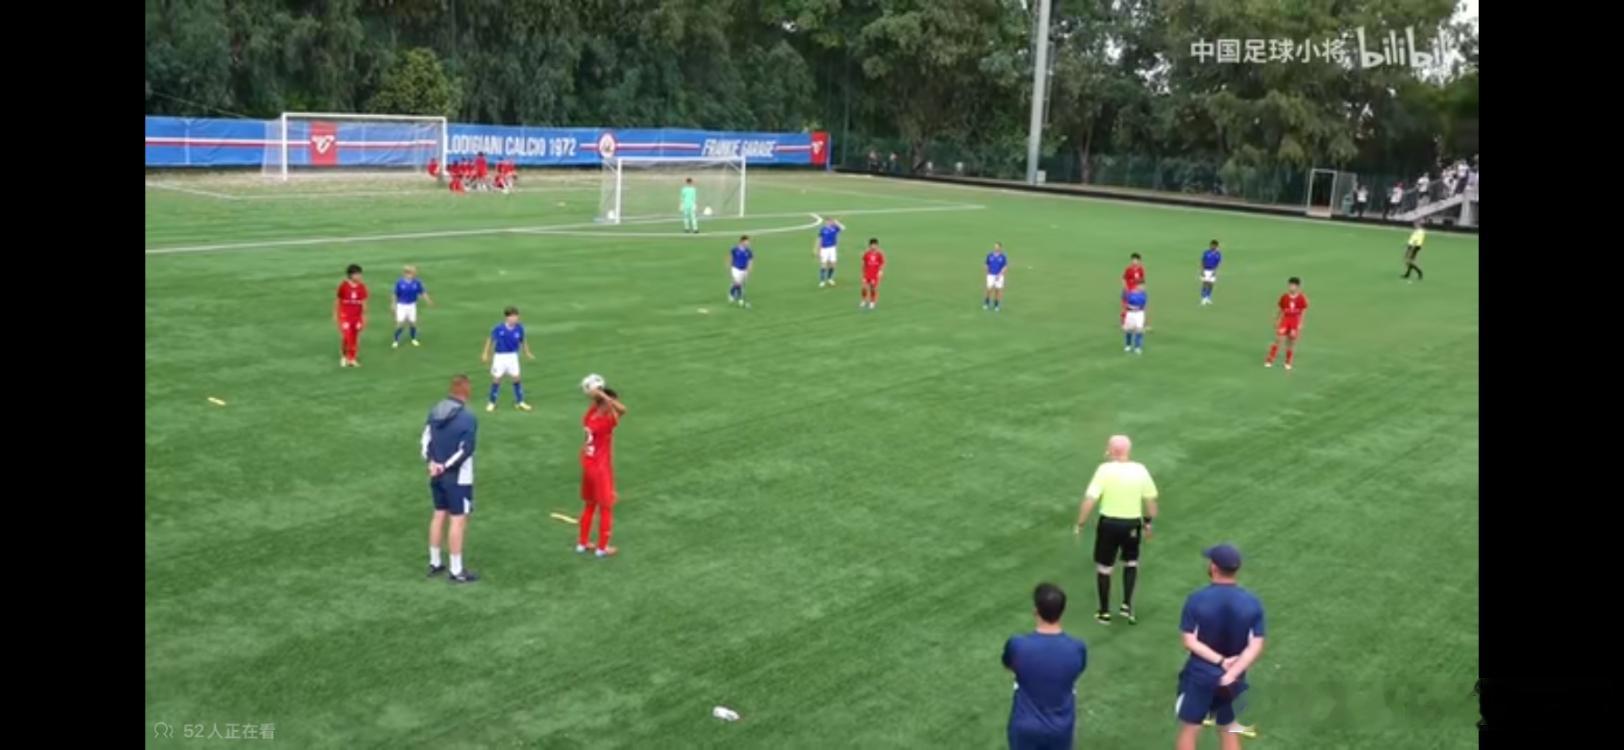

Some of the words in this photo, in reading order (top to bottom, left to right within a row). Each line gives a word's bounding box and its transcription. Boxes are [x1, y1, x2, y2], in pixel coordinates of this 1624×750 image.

[446, 134, 503, 155] LODIGIANI
[505, 136, 547, 157] CALCIO
[549, 137, 577, 157] 1972
[741, 139, 777, 158] GARAGE
